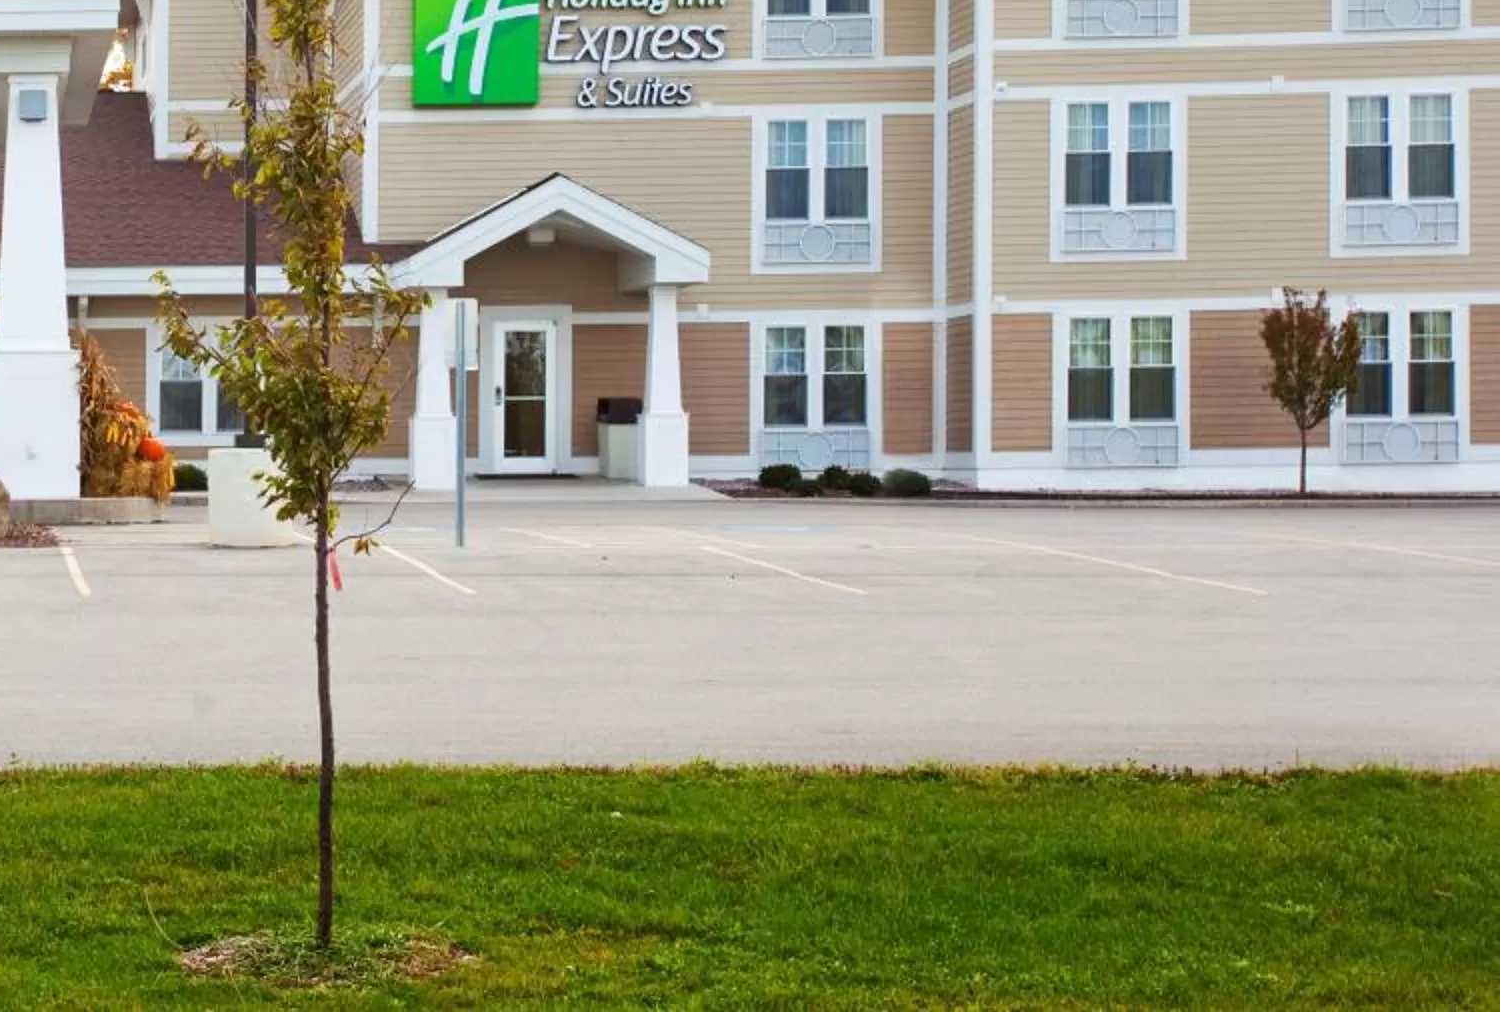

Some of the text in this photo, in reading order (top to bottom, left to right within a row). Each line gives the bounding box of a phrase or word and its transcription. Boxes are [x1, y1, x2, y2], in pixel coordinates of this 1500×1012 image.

[547, 15, 727, 73] Express
[577, 77, 693, 108] & Suites
